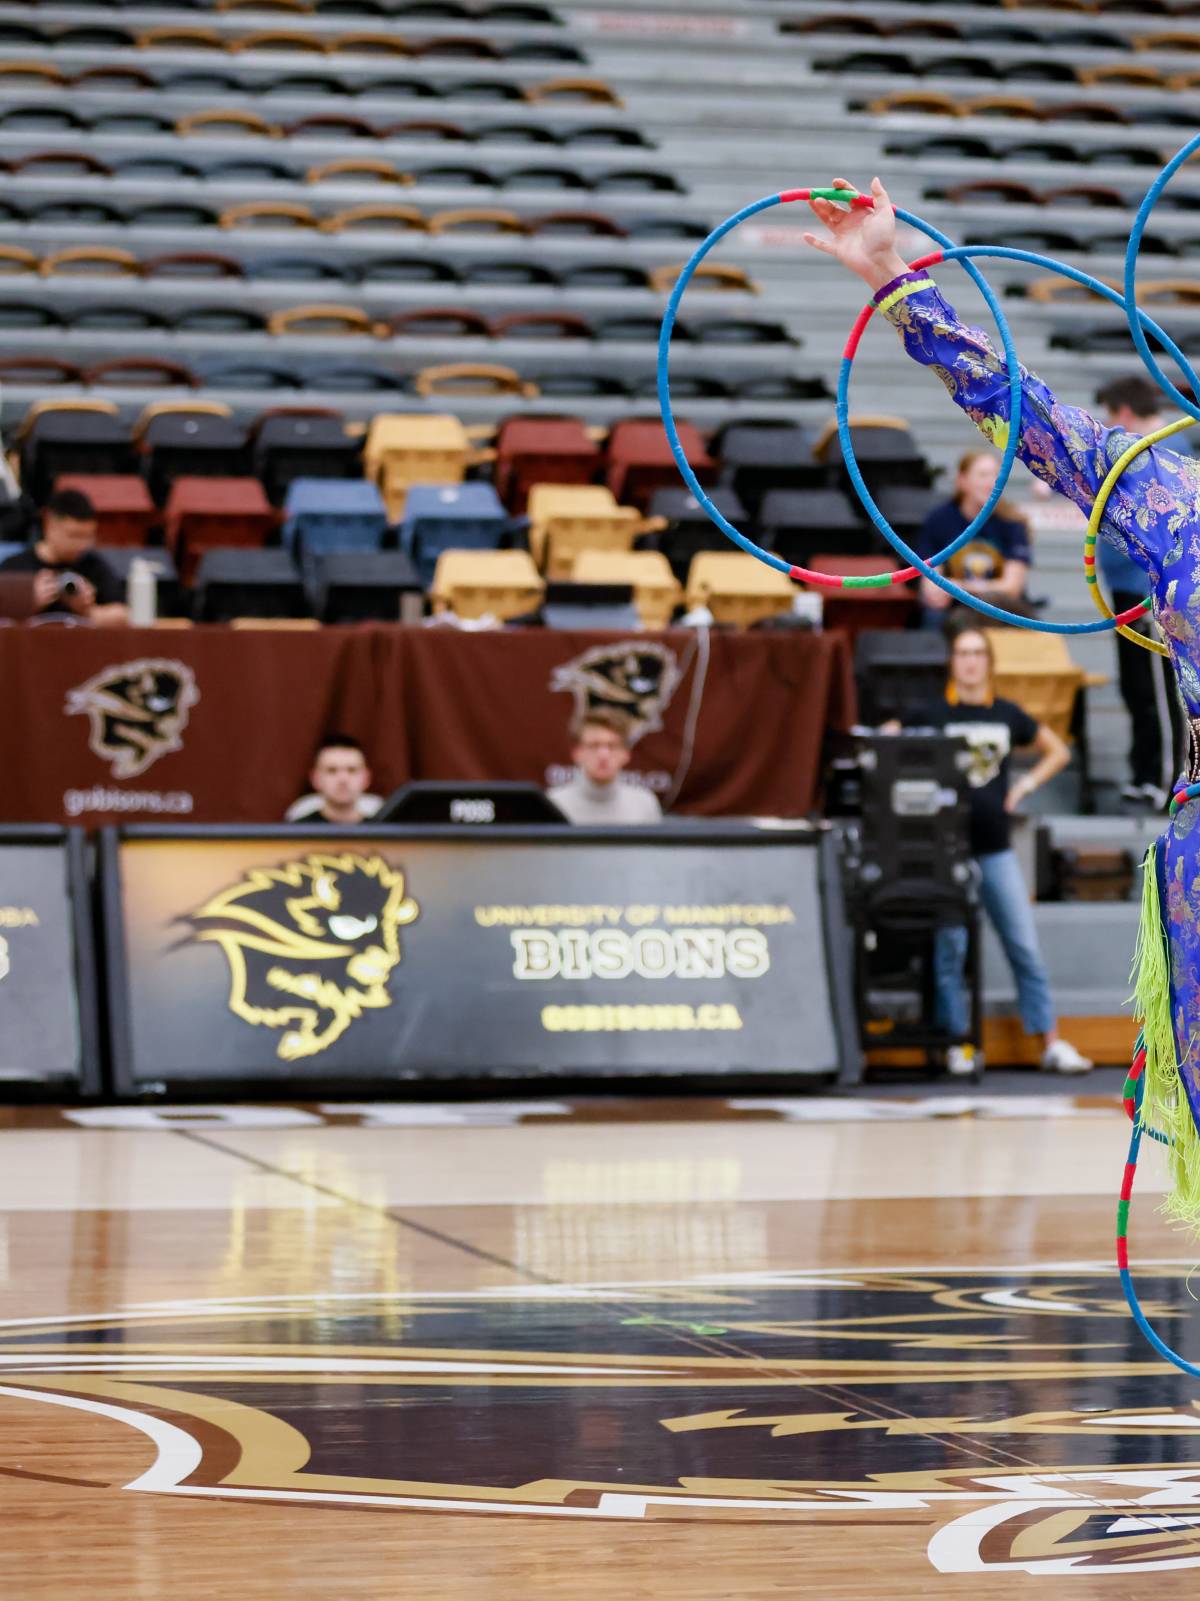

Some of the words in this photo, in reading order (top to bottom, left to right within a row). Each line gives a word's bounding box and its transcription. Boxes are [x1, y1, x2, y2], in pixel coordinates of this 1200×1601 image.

[475, 905, 623, 927] UNIVERSITY
[625, 905, 658, 925] OF
[664, 905, 796, 924] MANITOBA
[511, 929, 769, 979] BISONS
